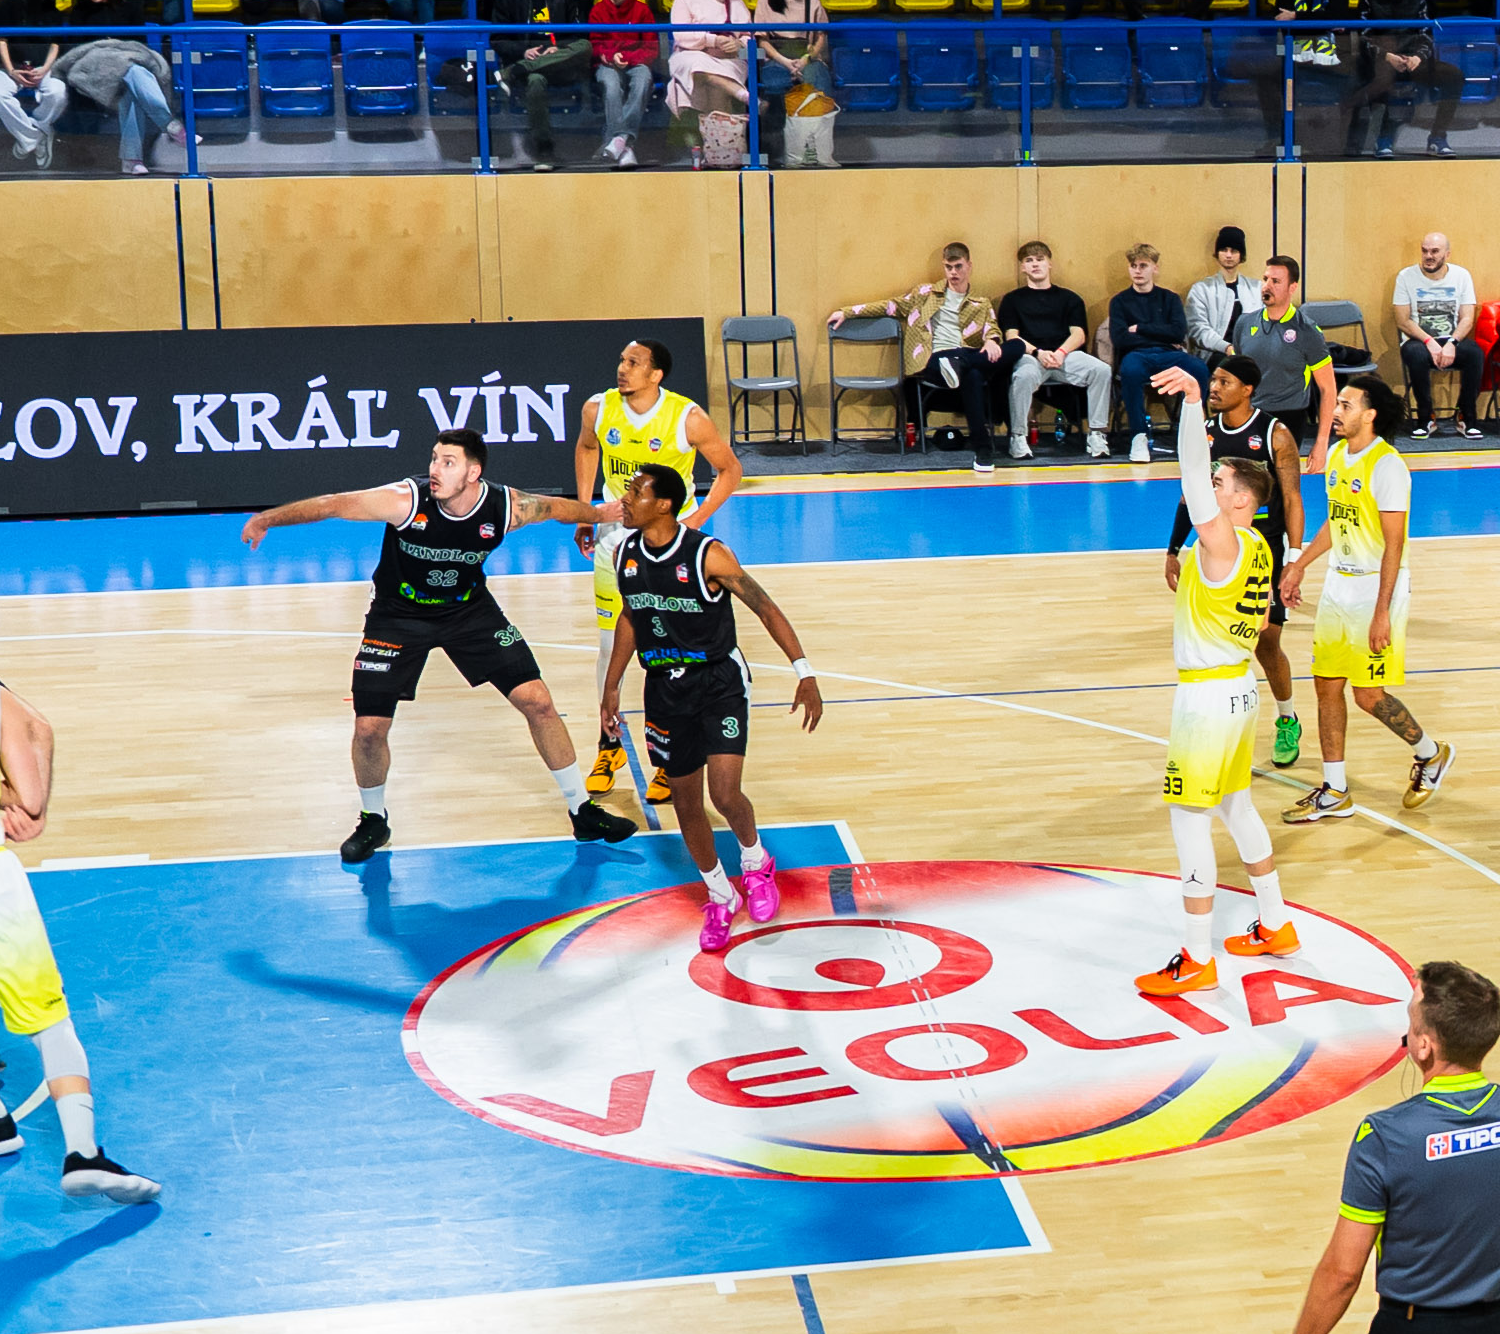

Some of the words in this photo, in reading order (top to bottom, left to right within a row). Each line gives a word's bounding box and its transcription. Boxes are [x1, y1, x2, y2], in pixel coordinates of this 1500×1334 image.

[173, 374, 401, 454] KRÁĽ
[419, 370, 570, 444] VÍN
[426, 569, 459, 587] 32
[494, 625, 523, 647] 32
[651, 616, 668, 638] 3
[1366, 662, 1386, 681] 14
[722, 717, 740, 739] 3
[1163, 776, 1183, 796] 33
[480, 967, 1399, 1137] VEOLIA
